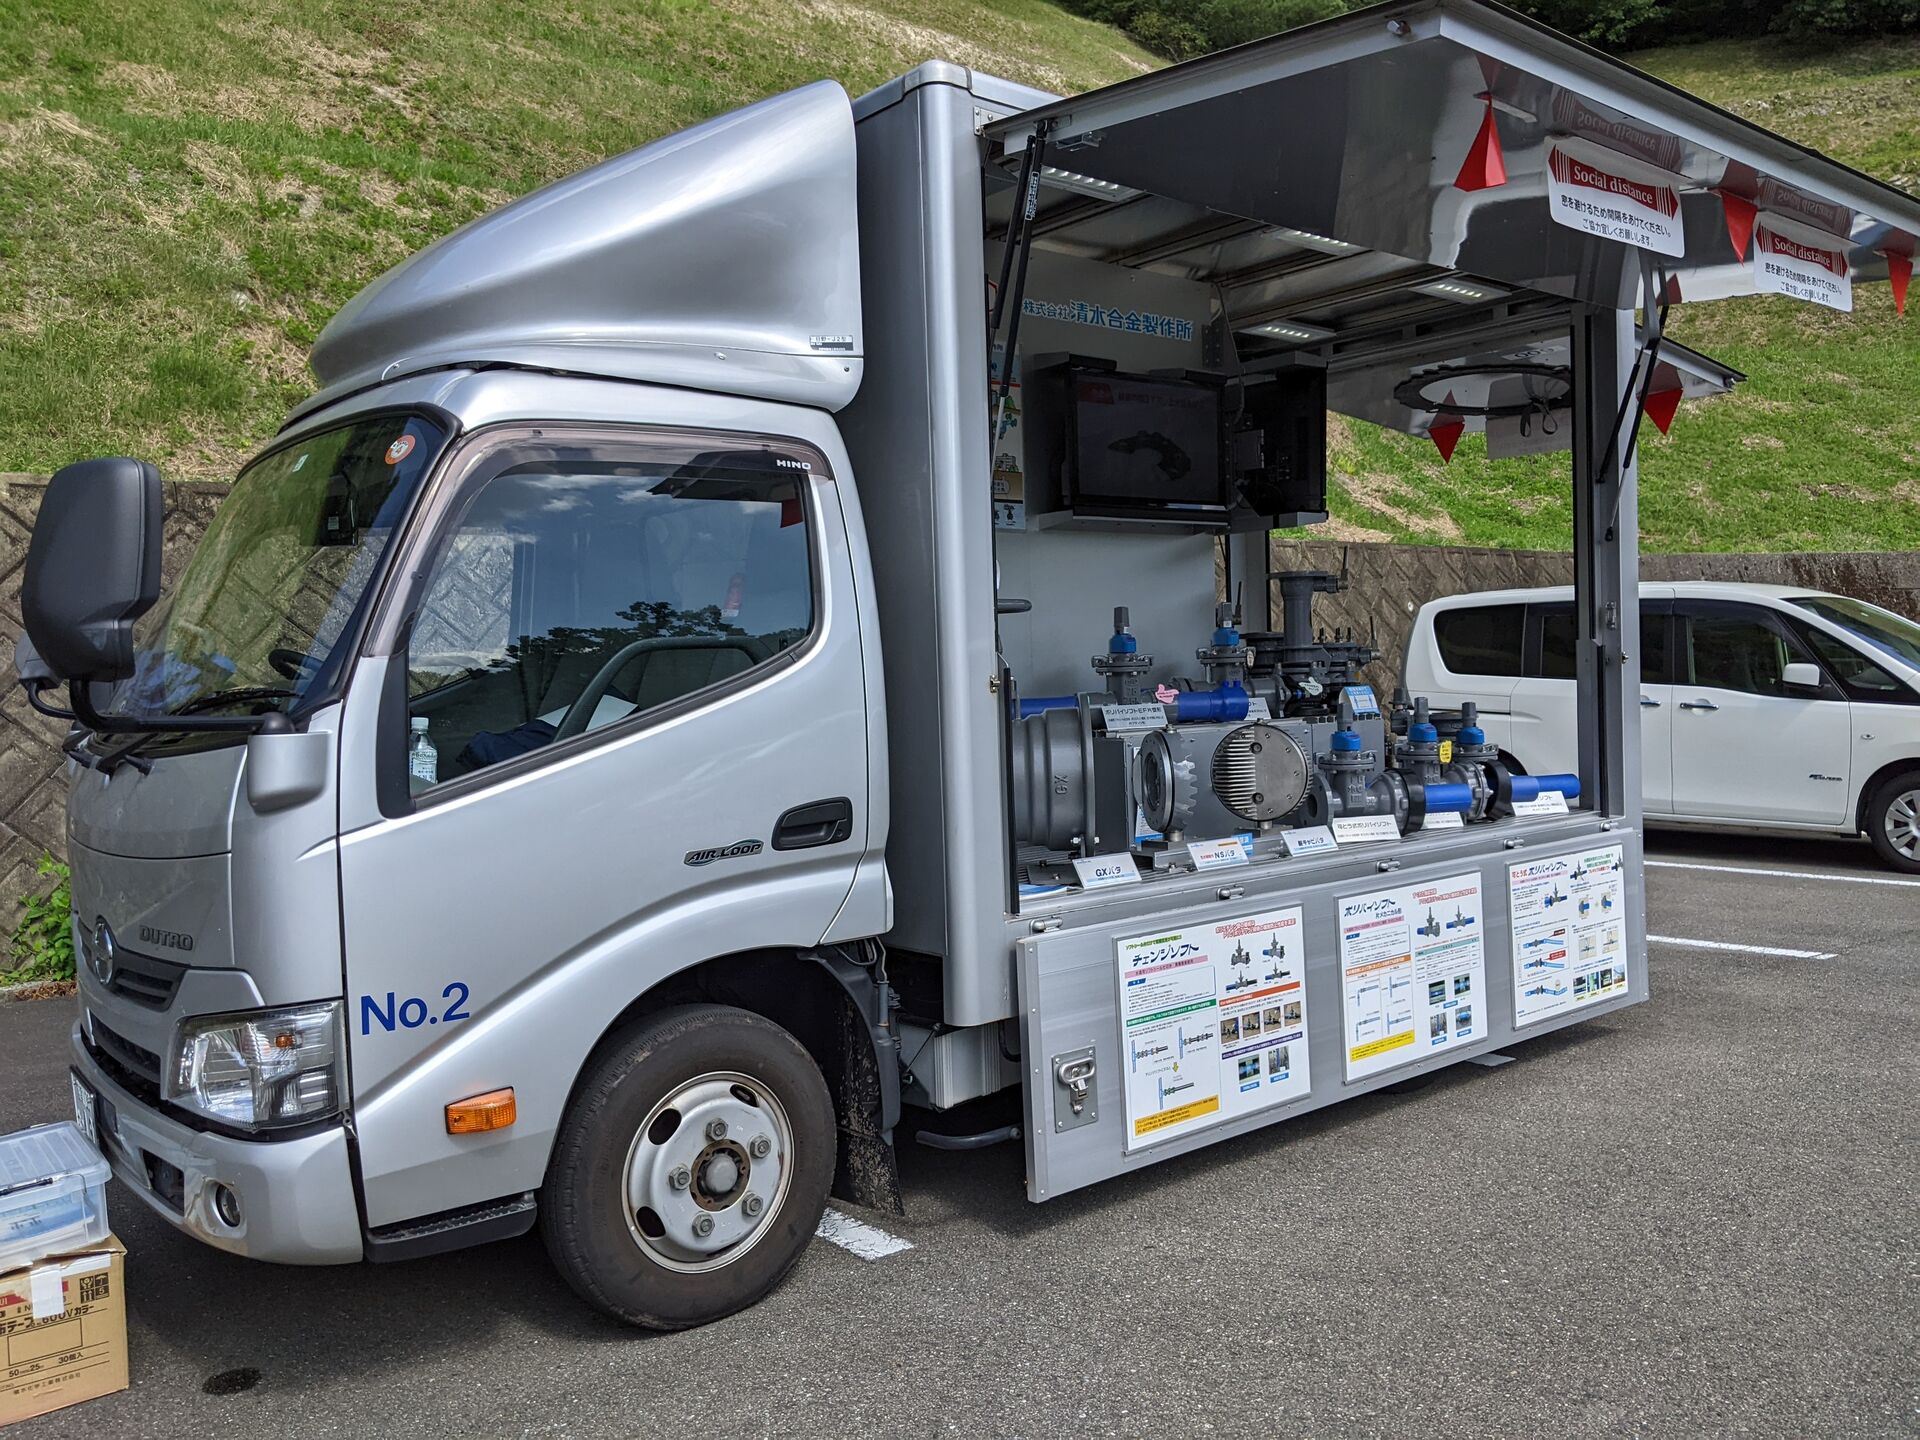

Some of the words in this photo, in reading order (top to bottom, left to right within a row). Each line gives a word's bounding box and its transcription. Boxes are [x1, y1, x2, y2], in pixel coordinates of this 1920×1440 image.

[1574, 165, 1607, 190] Social
[1610, 179, 1653, 204] distance
[1560, 194, 1671, 238] 密を避けるため間隔をあけてください。
[1582, 218, 1654, 248] ご協力宜しくお願いします。
[1774, 237, 1797, 258] Social
[1798, 244, 1831, 267] distance
[1023, 299, 1192, 341] 株式会社清水合金製作所
[776, 459, 811, 470] HINO
[688, 850, 718, 861] AIR
[720, 843, 762, 857] LOOP
[1095, 866, 1121, 877] GXバタ
[139, 924, 193, 951] DUTRO
[1132, 943, 1200, 967] チェンジソフト
[361, 982, 470, 1035] No.2
